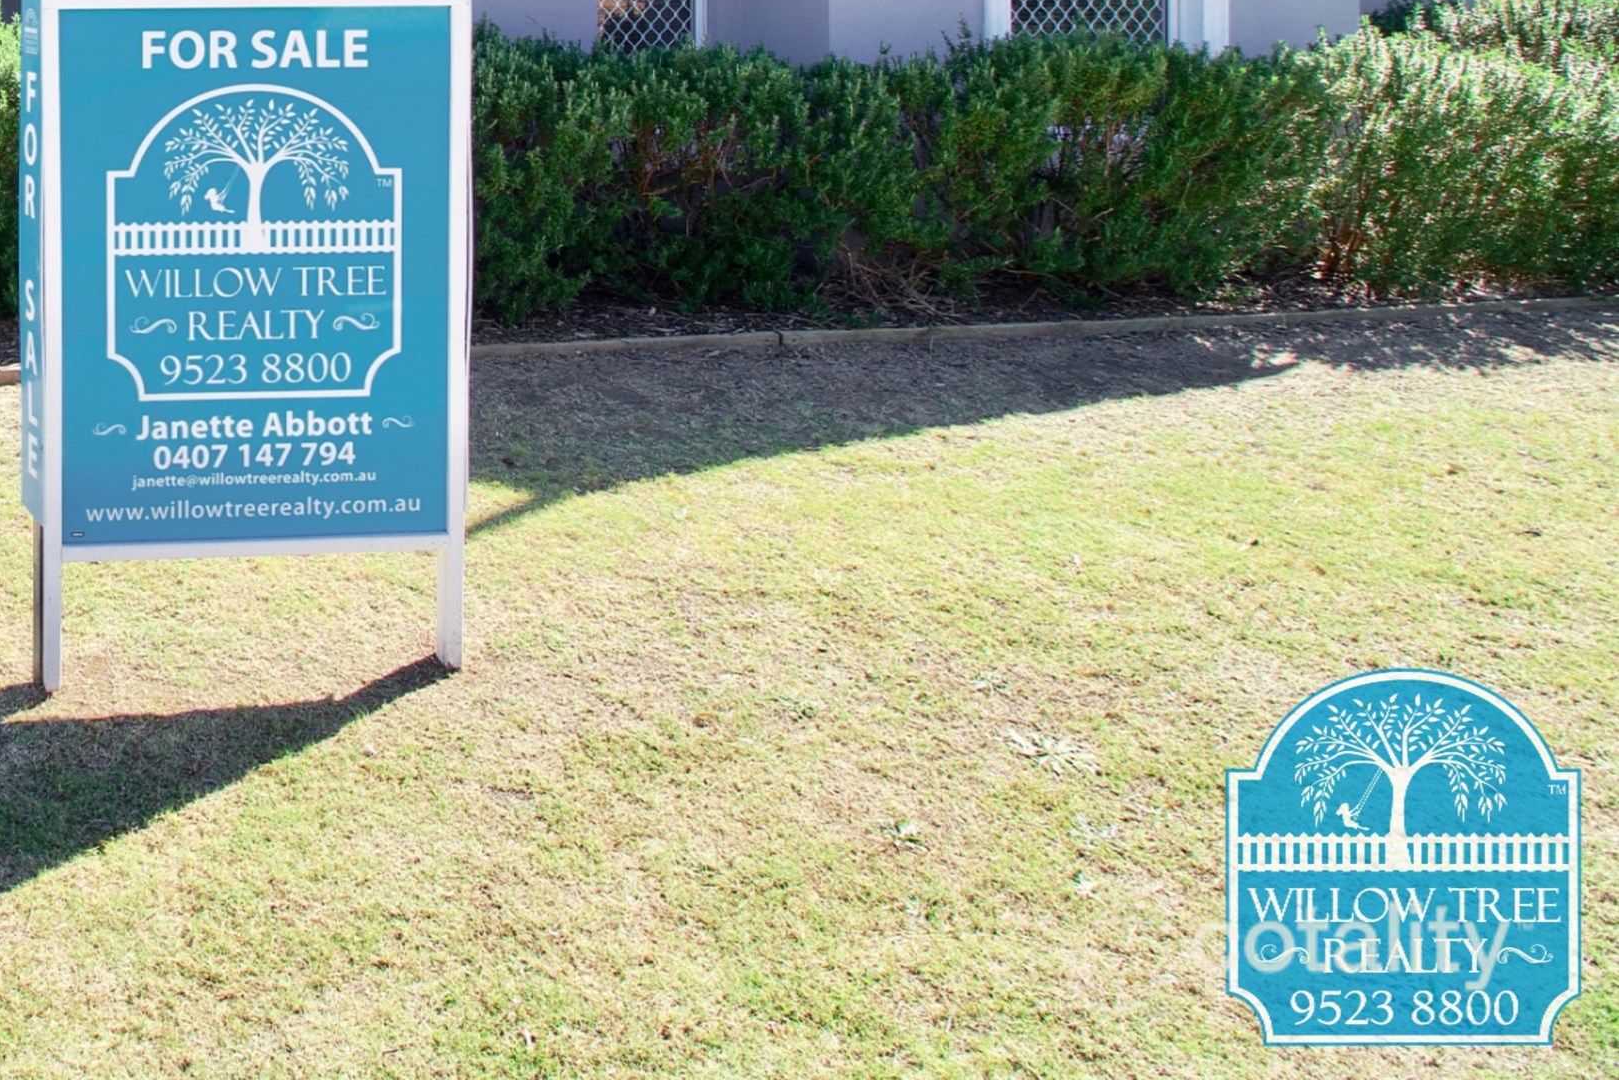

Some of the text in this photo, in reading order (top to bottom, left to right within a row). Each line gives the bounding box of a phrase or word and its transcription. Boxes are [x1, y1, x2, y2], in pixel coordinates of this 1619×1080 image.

[141, 29, 369, 69] FOR SALE
[24, 71, 38, 220] FOR
[376, 178, 393, 187] TM
[124, 265, 387, 298] WILLOW TREE
[186, 309, 326, 342] REALTY
[23, 278, 39, 480] SALE
[159, 352, 352, 386] 9523 8800
[136, 410, 373, 441] Janette Abbott
[153, 441, 356, 470] 0407 147 794
[131, 471, 376, 491] janette@willowtreerealty.com.au
[86, 495, 421, 523] www.willowtreerealty.com.au
